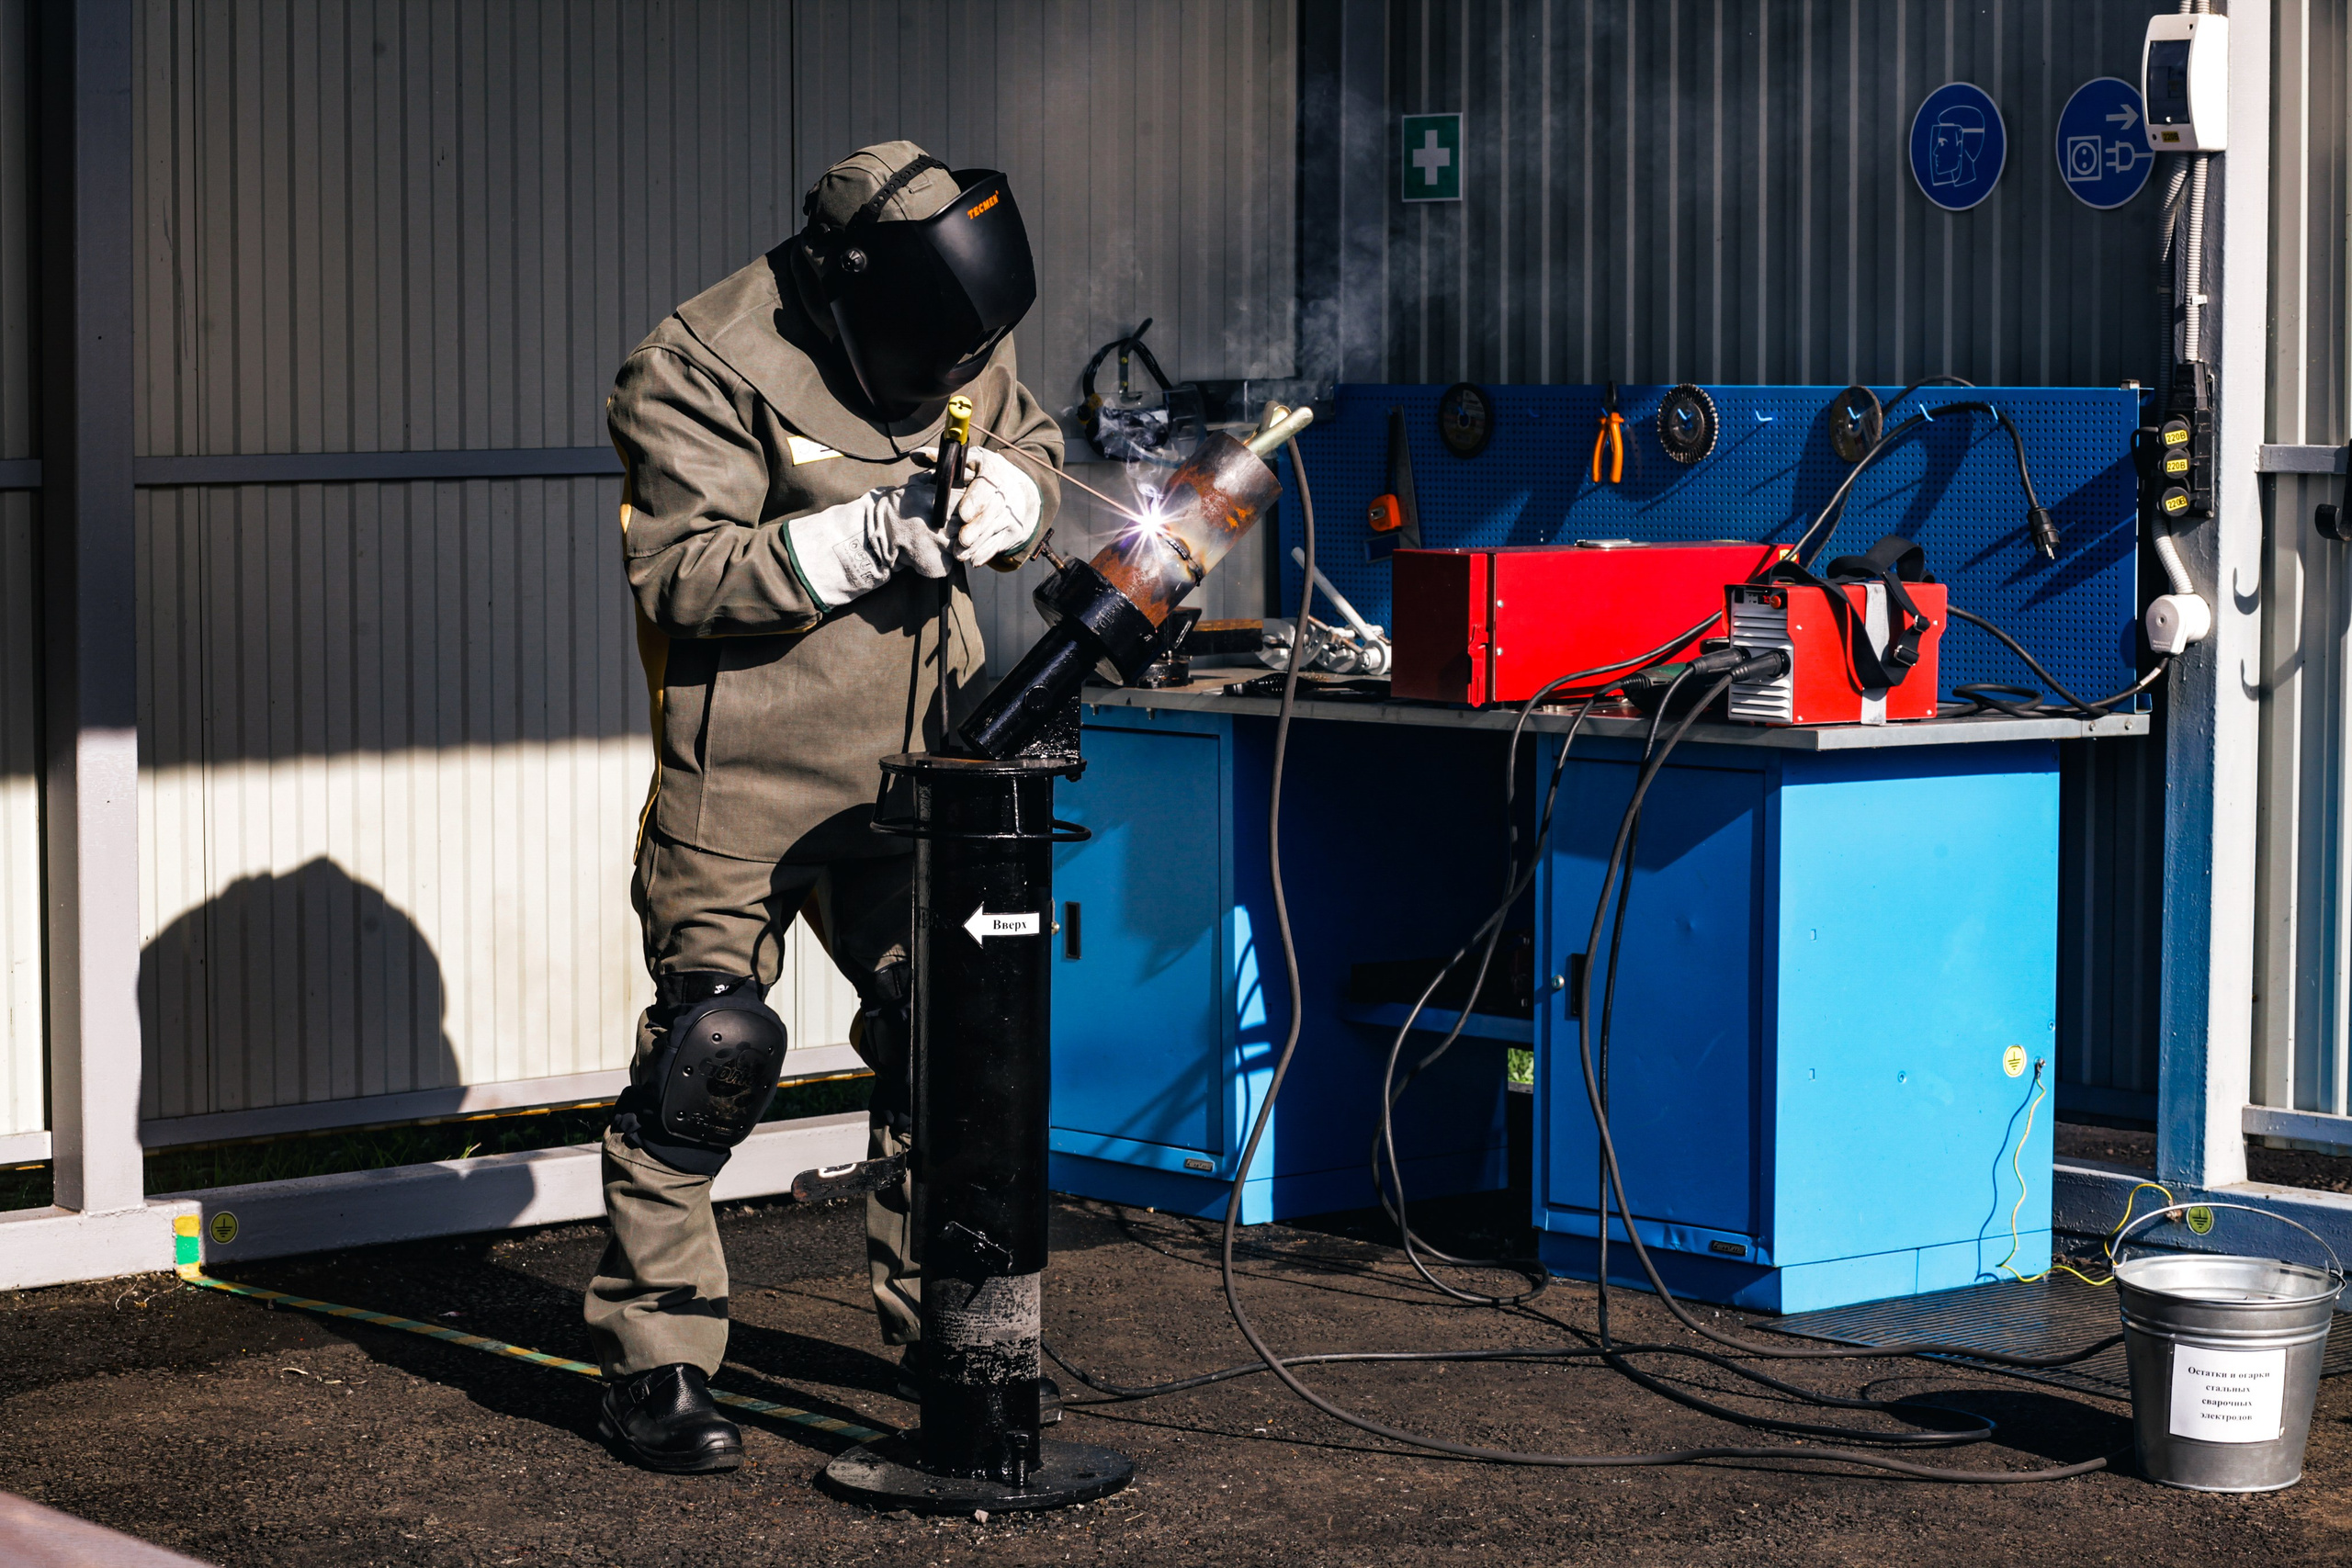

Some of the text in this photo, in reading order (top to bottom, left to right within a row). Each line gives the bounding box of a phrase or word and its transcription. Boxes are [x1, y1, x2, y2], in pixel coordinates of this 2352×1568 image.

[967, 194, 999, 220] TECMEN
[993, 919, 1026, 931] Вверх
[2188, 1366, 2227, 1378] Остатки
[2205, 1384, 2250, 1393] стальных
[2201, 1398, 2252, 1407] сварочных
[2200, 1413, 2253, 1422] электродов
